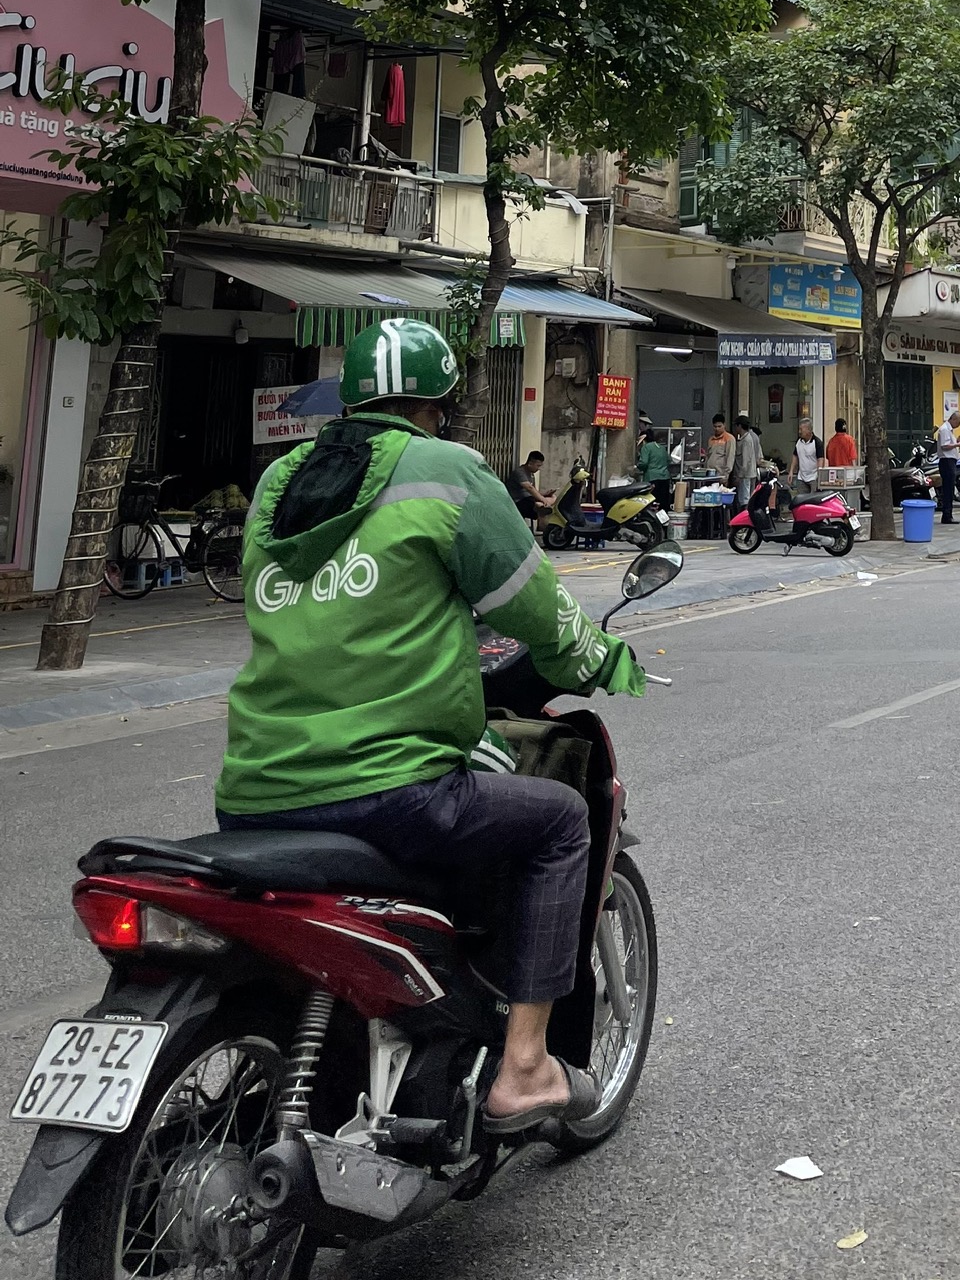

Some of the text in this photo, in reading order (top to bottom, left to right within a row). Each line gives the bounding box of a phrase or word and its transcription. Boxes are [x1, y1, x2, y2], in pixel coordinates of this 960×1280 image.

[21, 111, 59, 137] tặng
[50, 1026, 144, 1070] 29-E2
[20, 1072, 133, 1122] 877.73
